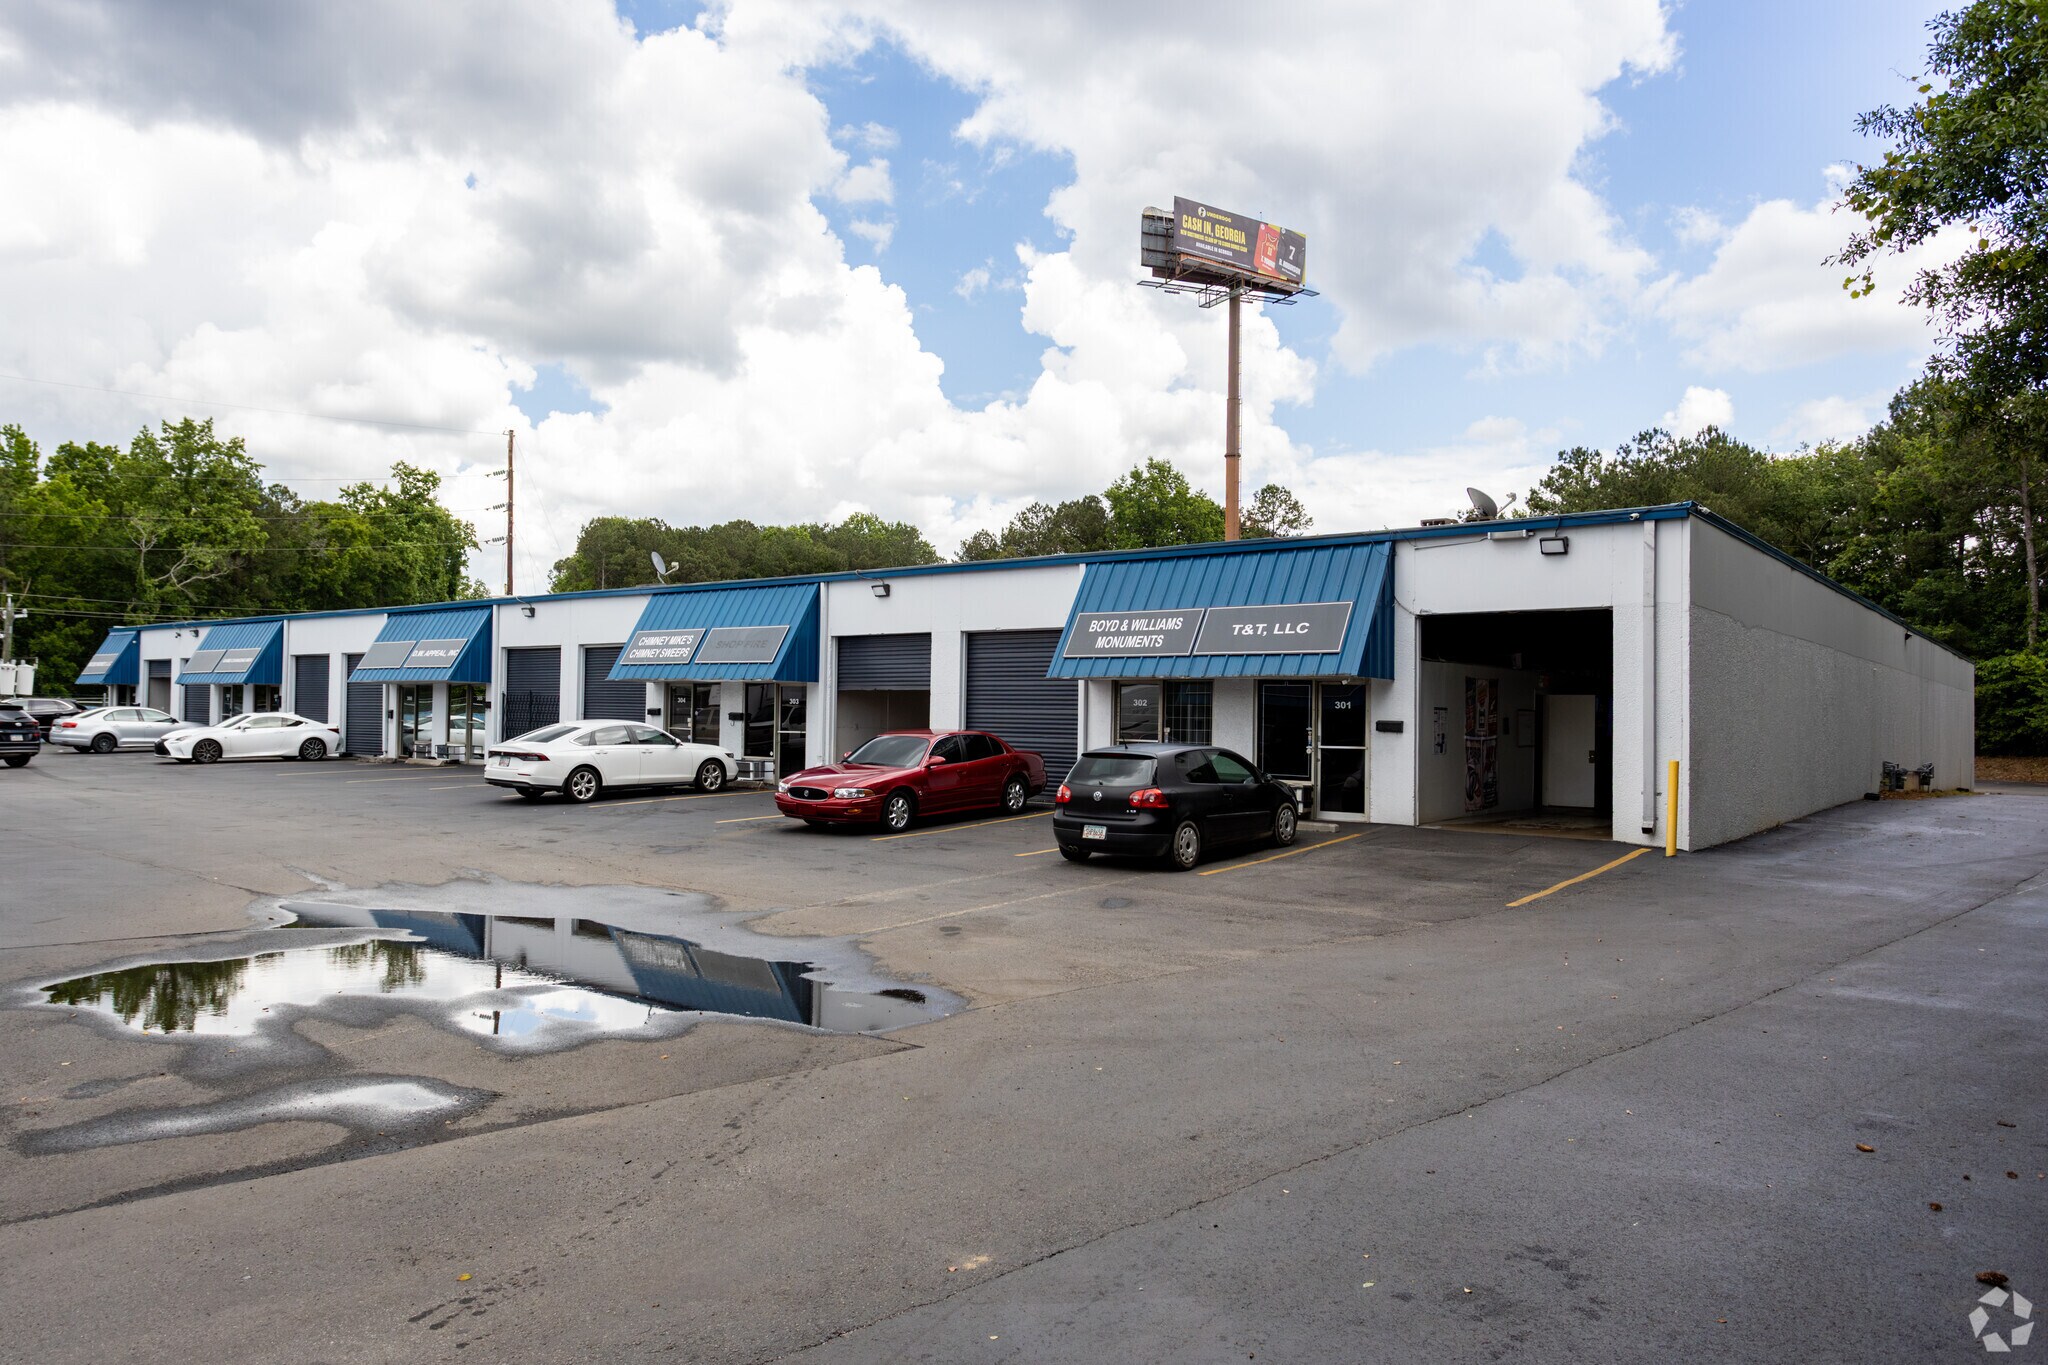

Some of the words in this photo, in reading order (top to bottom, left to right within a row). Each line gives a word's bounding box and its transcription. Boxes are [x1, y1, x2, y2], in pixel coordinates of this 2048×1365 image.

[1206, 211, 1232, 223] UNDERDOG
[1182, 214, 1203, 233] CASH
[1203, 220, 1214, 237] IN,
[1215, 224, 1246, 245] GEORGIA
[1289, 245, 1296, 260] 7
[1088, 619, 1120, 632] BOYD
[1120, 618, 1129, 632] &
[1131, 617, 1184, 631] WILLIAMS
[1232, 623, 1268, 637] T&T,
[1273, 622, 1310, 635] LLC
[638, 636, 671, 646] CHIMNEY
[668, 635, 694, 645] MIKE'S
[1095, 634, 1164, 649] MONUMENTS
[629, 648, 662, 659] CHIMNEY
[659, 647, 690, 658] SWEEPS
[1133, 698, 1148, 707] 302
[1334, 701, 1351, 710] 301
